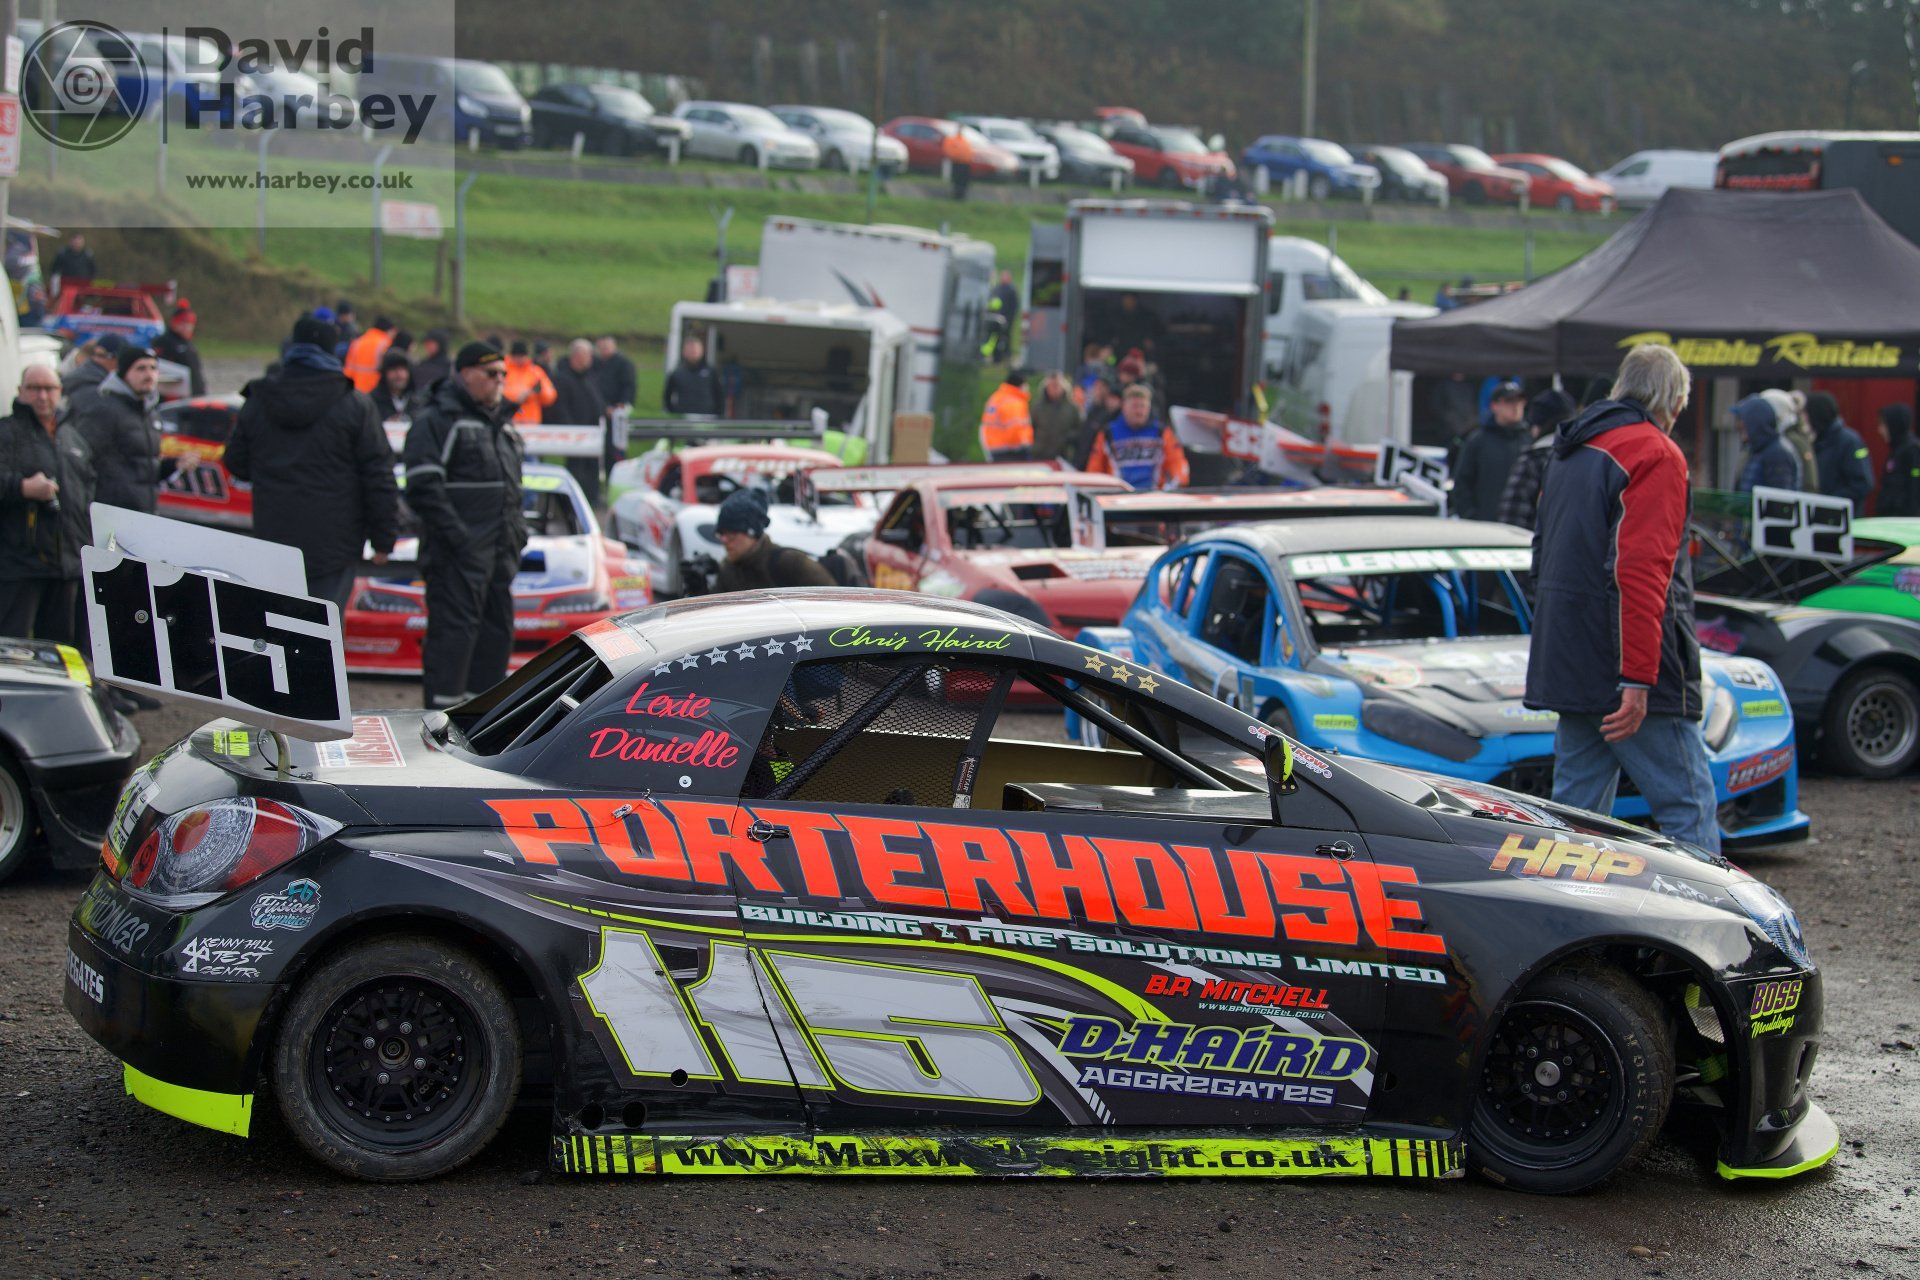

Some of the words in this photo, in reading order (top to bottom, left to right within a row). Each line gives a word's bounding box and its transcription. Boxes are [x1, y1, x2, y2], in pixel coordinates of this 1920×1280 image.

[1765, 332, 1901, 369] Rentals
[1758, 498, 1849, 558] 22
[1290, 550, 1459, 576] GLENN
[92, 557, 340, 721] 115
[829, 624, 910, 651] Chris
[918, 627, 1011, 652] Haird
[625, 682, 711, 718] Lexie
[588, 727, 739, 768] Danielle
[1488, 832, 1648, 883] HRP
[482, 798, 1447, 955] PORTERHOUSE
[253, 895, 316, 916] Fusion
[199, 937, 243, 951] KENNY
[243, 939, 275, 952] HILL
[211, 950, 275, 966] TEST
[738, 904, 921, 936] BUILDING
[933, 923, 956, 940] &
[968, 924, 1058, 950] FIRE
[1067, 934, 1282, 969] SOLUTIONS
[1294, 955, 1447, 985] LIMITED
[1144, 974, 1193, 998] B.P.
[1200, 978, 1330, 1009] MITCHELL
[1750, 979, 1803, 1020] BOSS
[577, 926, 1043, 1106] 115
[1198, 1001, 1327, 1020] WWW.BPMITCHELL.CO.UK
[1751, 1012, 1796, 1039] Mouldings
